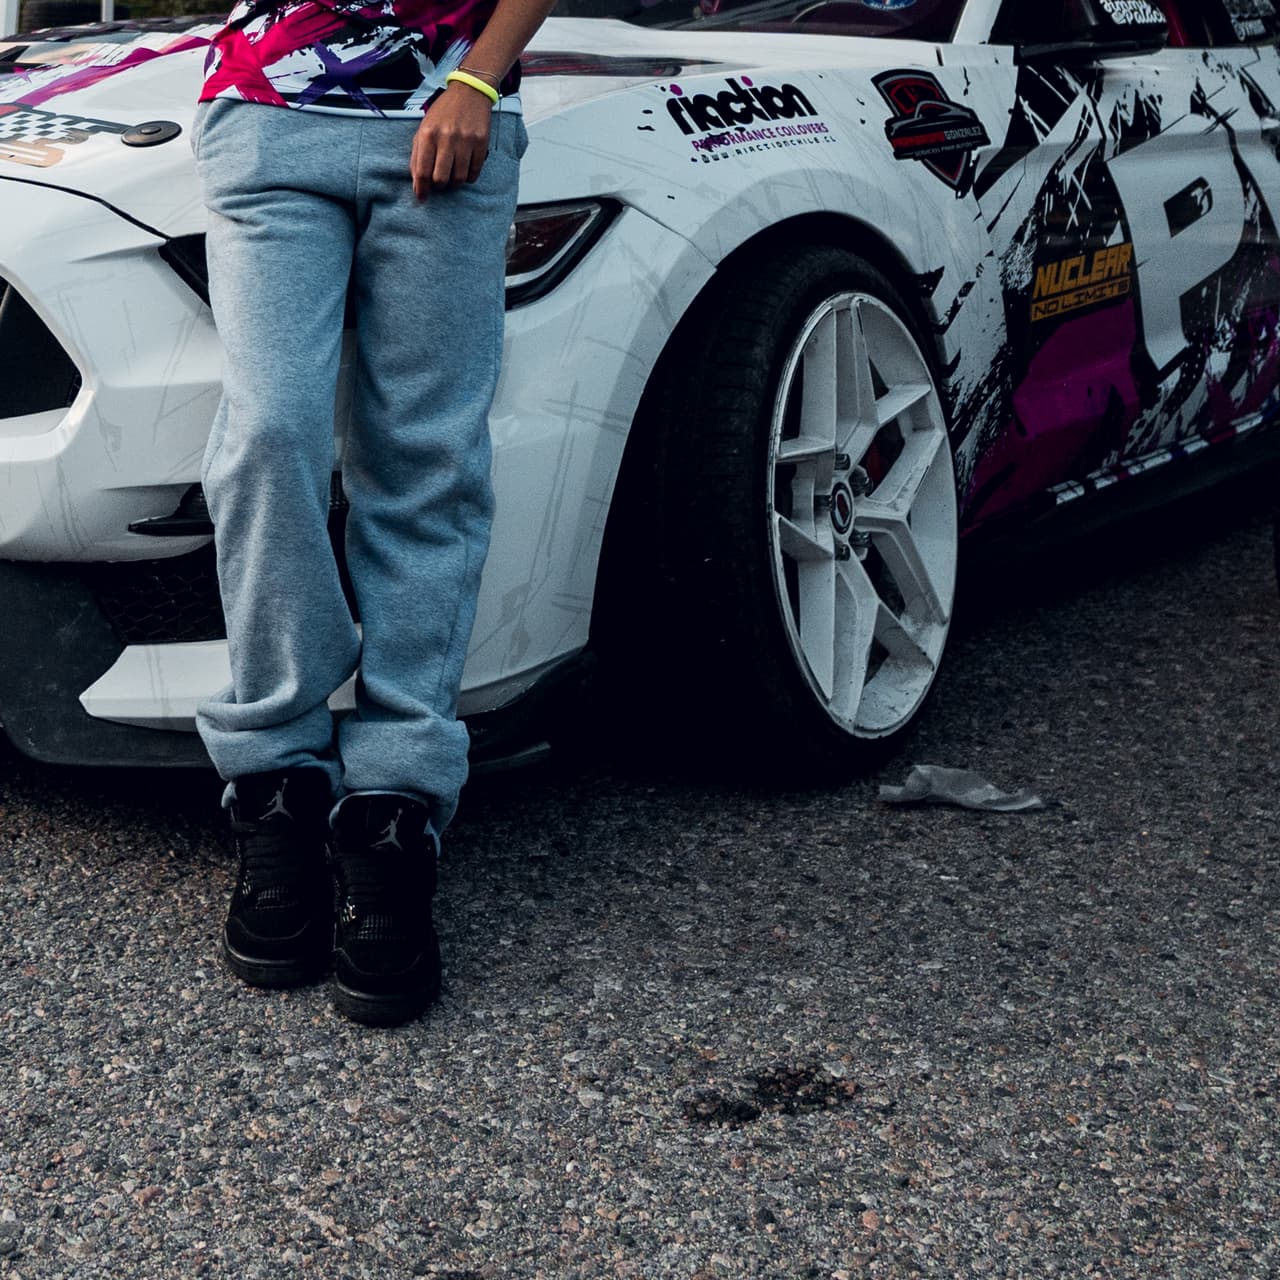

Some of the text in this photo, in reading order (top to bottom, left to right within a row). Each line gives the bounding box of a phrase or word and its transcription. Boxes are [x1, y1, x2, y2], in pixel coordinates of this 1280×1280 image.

[691, 122, 829, 152] PERFORMANCE COILOVERS
[1032, 242, 1133, 300] NUCLEAR
